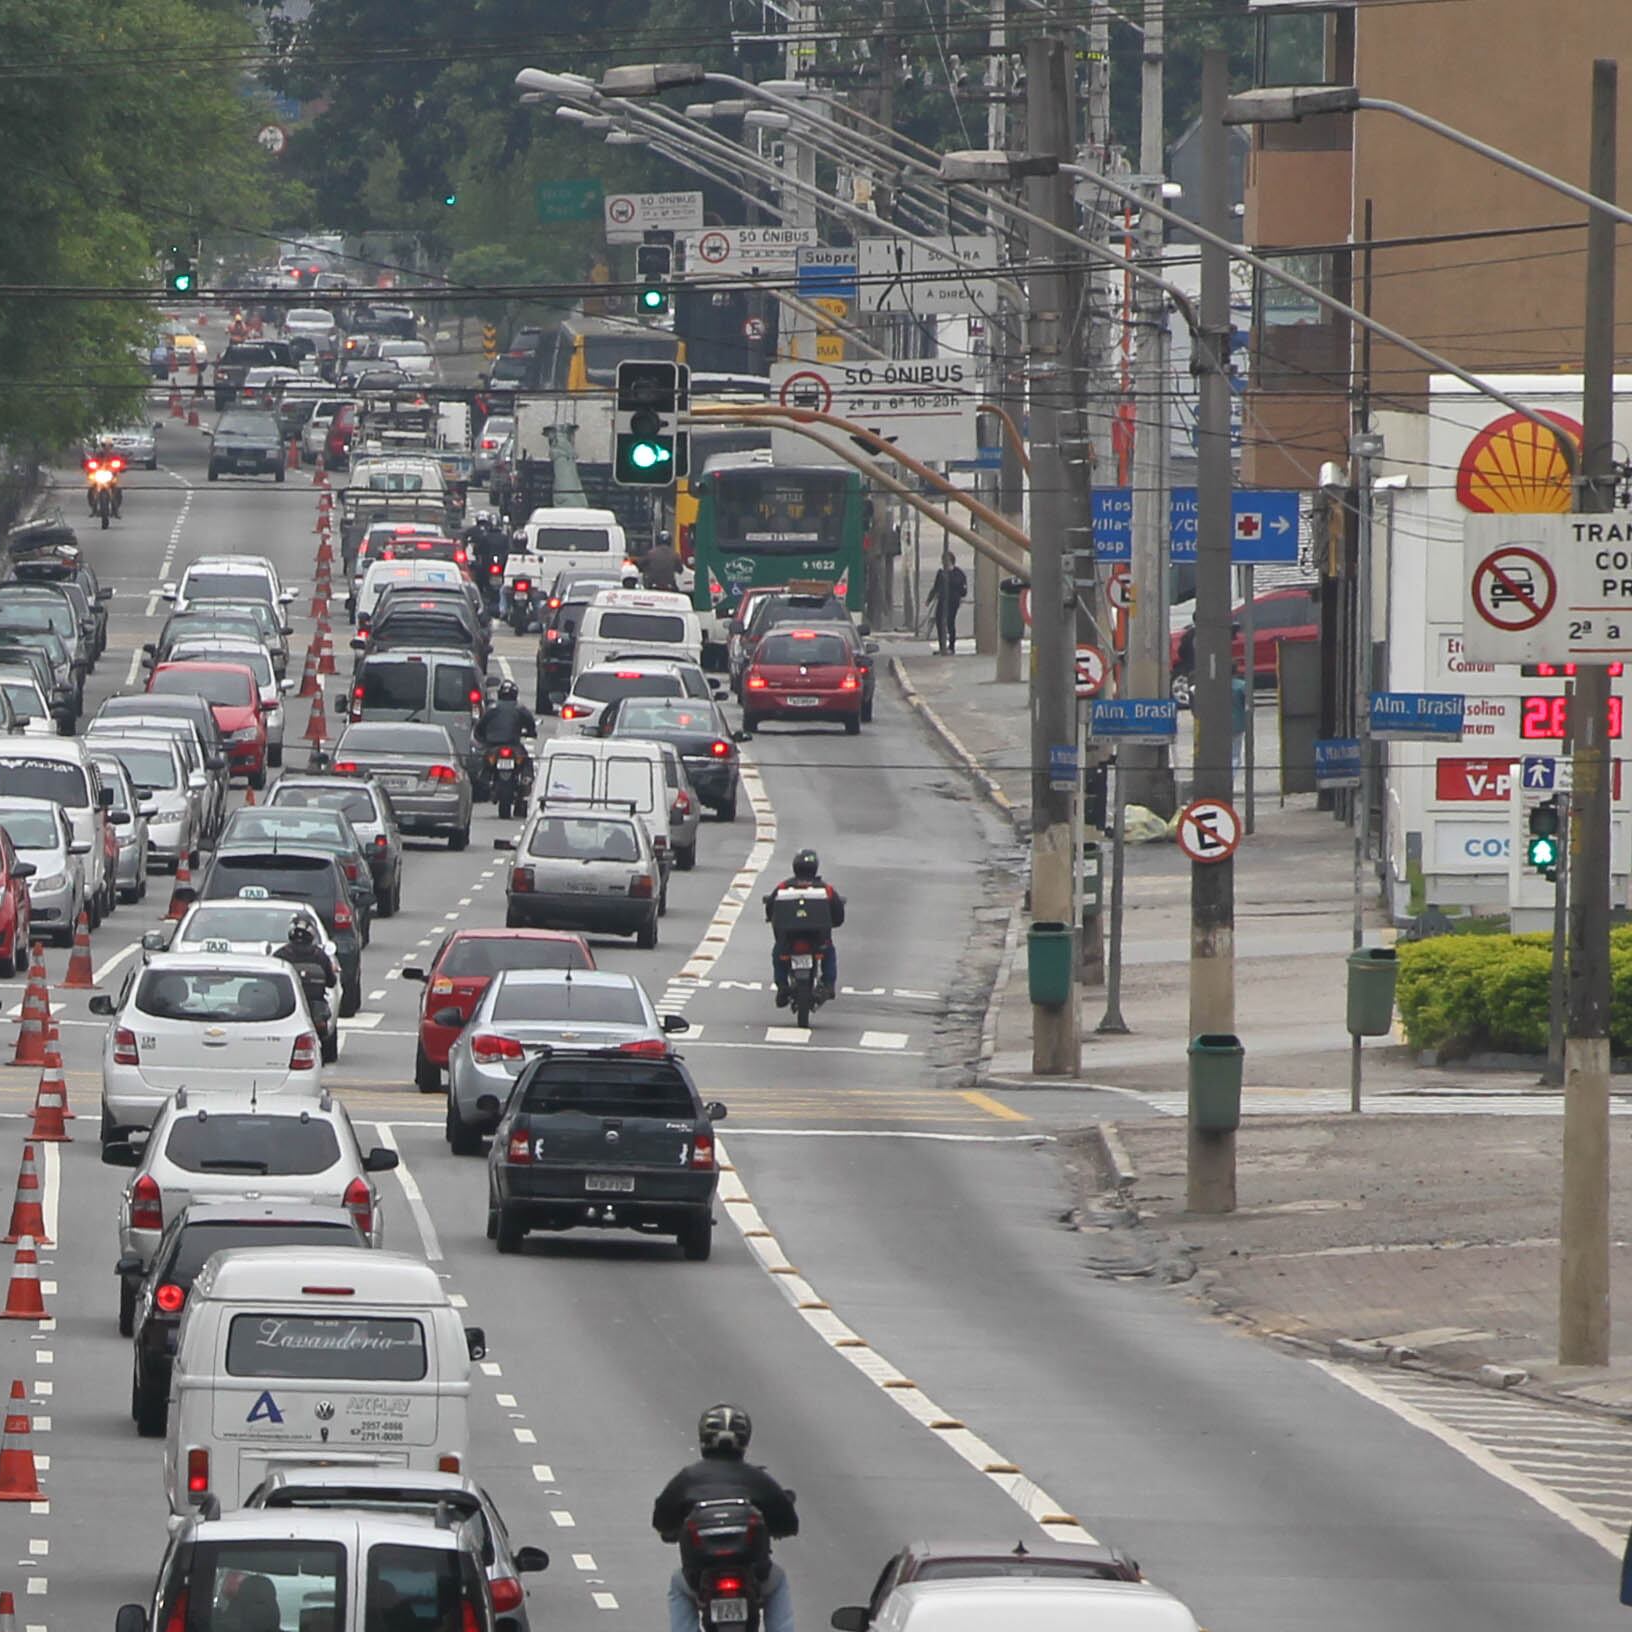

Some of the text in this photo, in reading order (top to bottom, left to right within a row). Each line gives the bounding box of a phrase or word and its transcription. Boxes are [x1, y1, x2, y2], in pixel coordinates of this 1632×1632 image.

[884, 363, 964, 384] ÔNIBUS
[1607, 625, 1620, 639] a
[1135, 702, 1177, 718] Brasil
[1374, 697, 1463, 715] Alm. Brasil
[245, 889, 265, 897] TAXI
[206, 941, 228, 951] TAXI
[256, 1318, 394, 1349] Lavanderia
